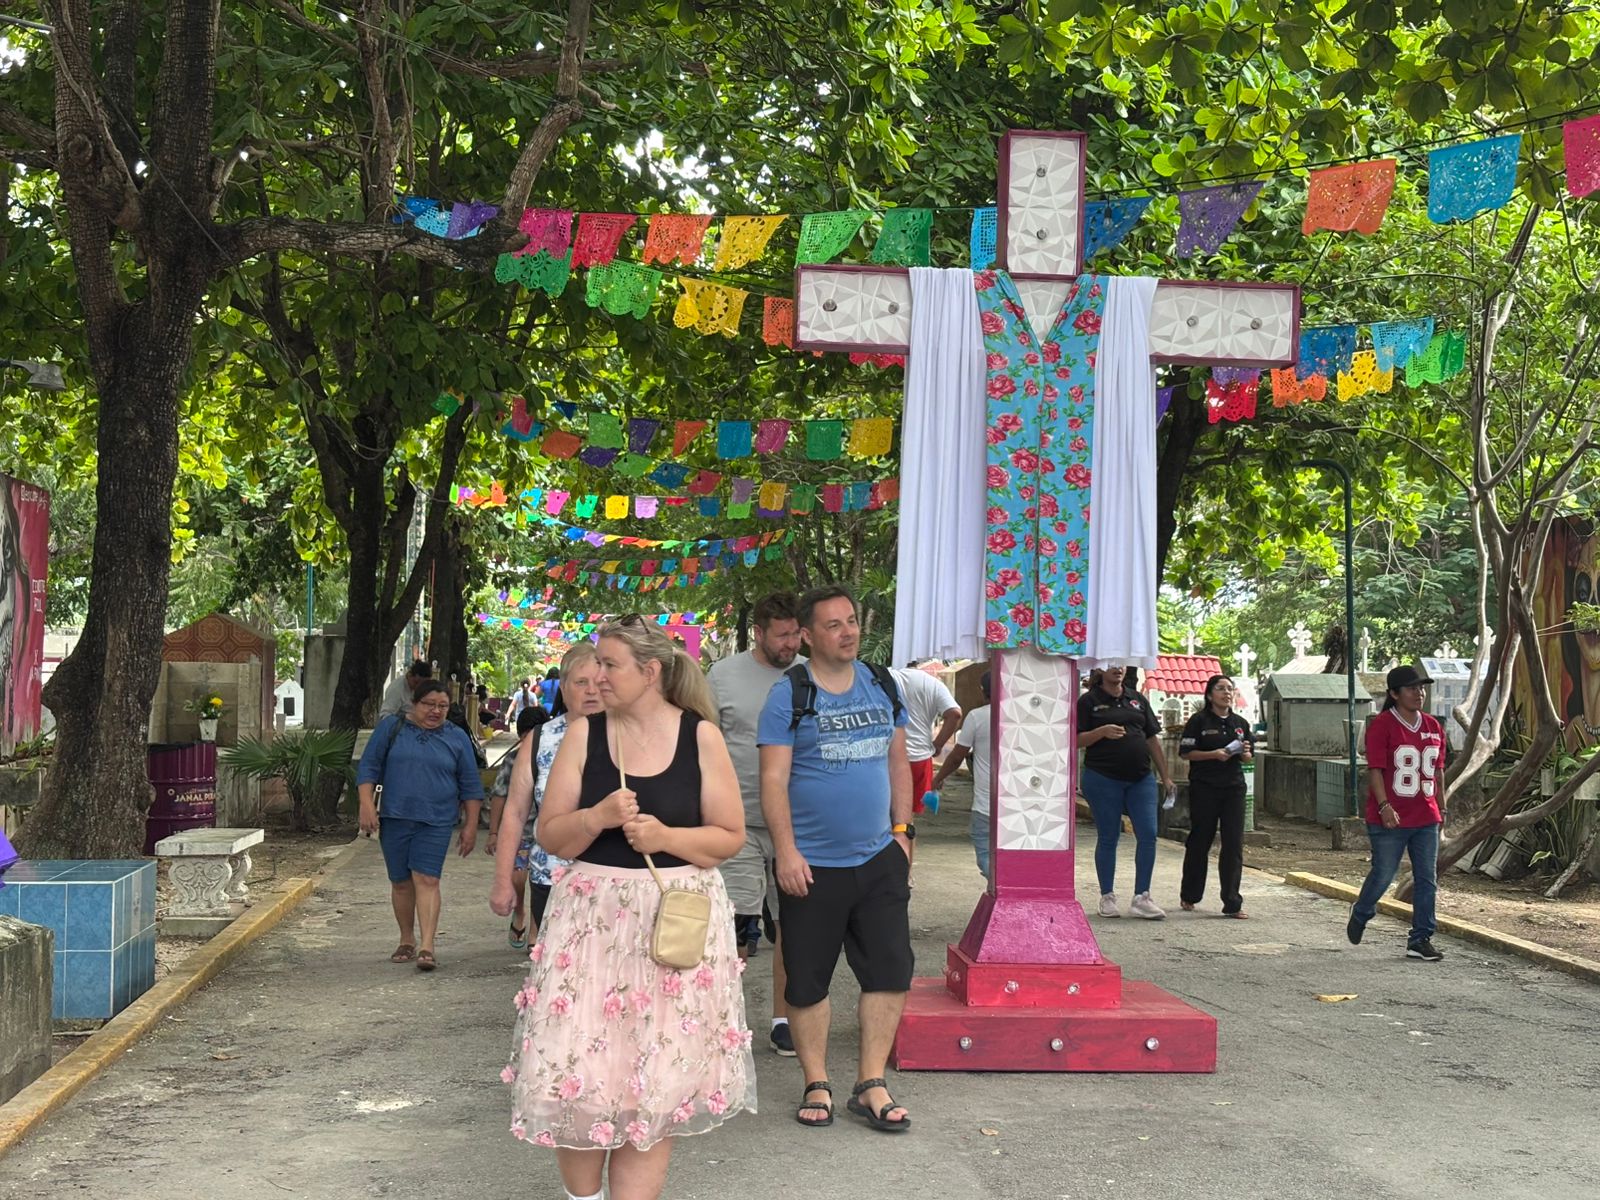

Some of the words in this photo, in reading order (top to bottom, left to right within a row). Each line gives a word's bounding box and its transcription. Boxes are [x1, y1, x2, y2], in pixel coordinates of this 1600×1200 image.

[832, 711, 879, 729] STILL
[1392, 744, 1441, 798] 89
[174, 793, 203, 803] JANAL
